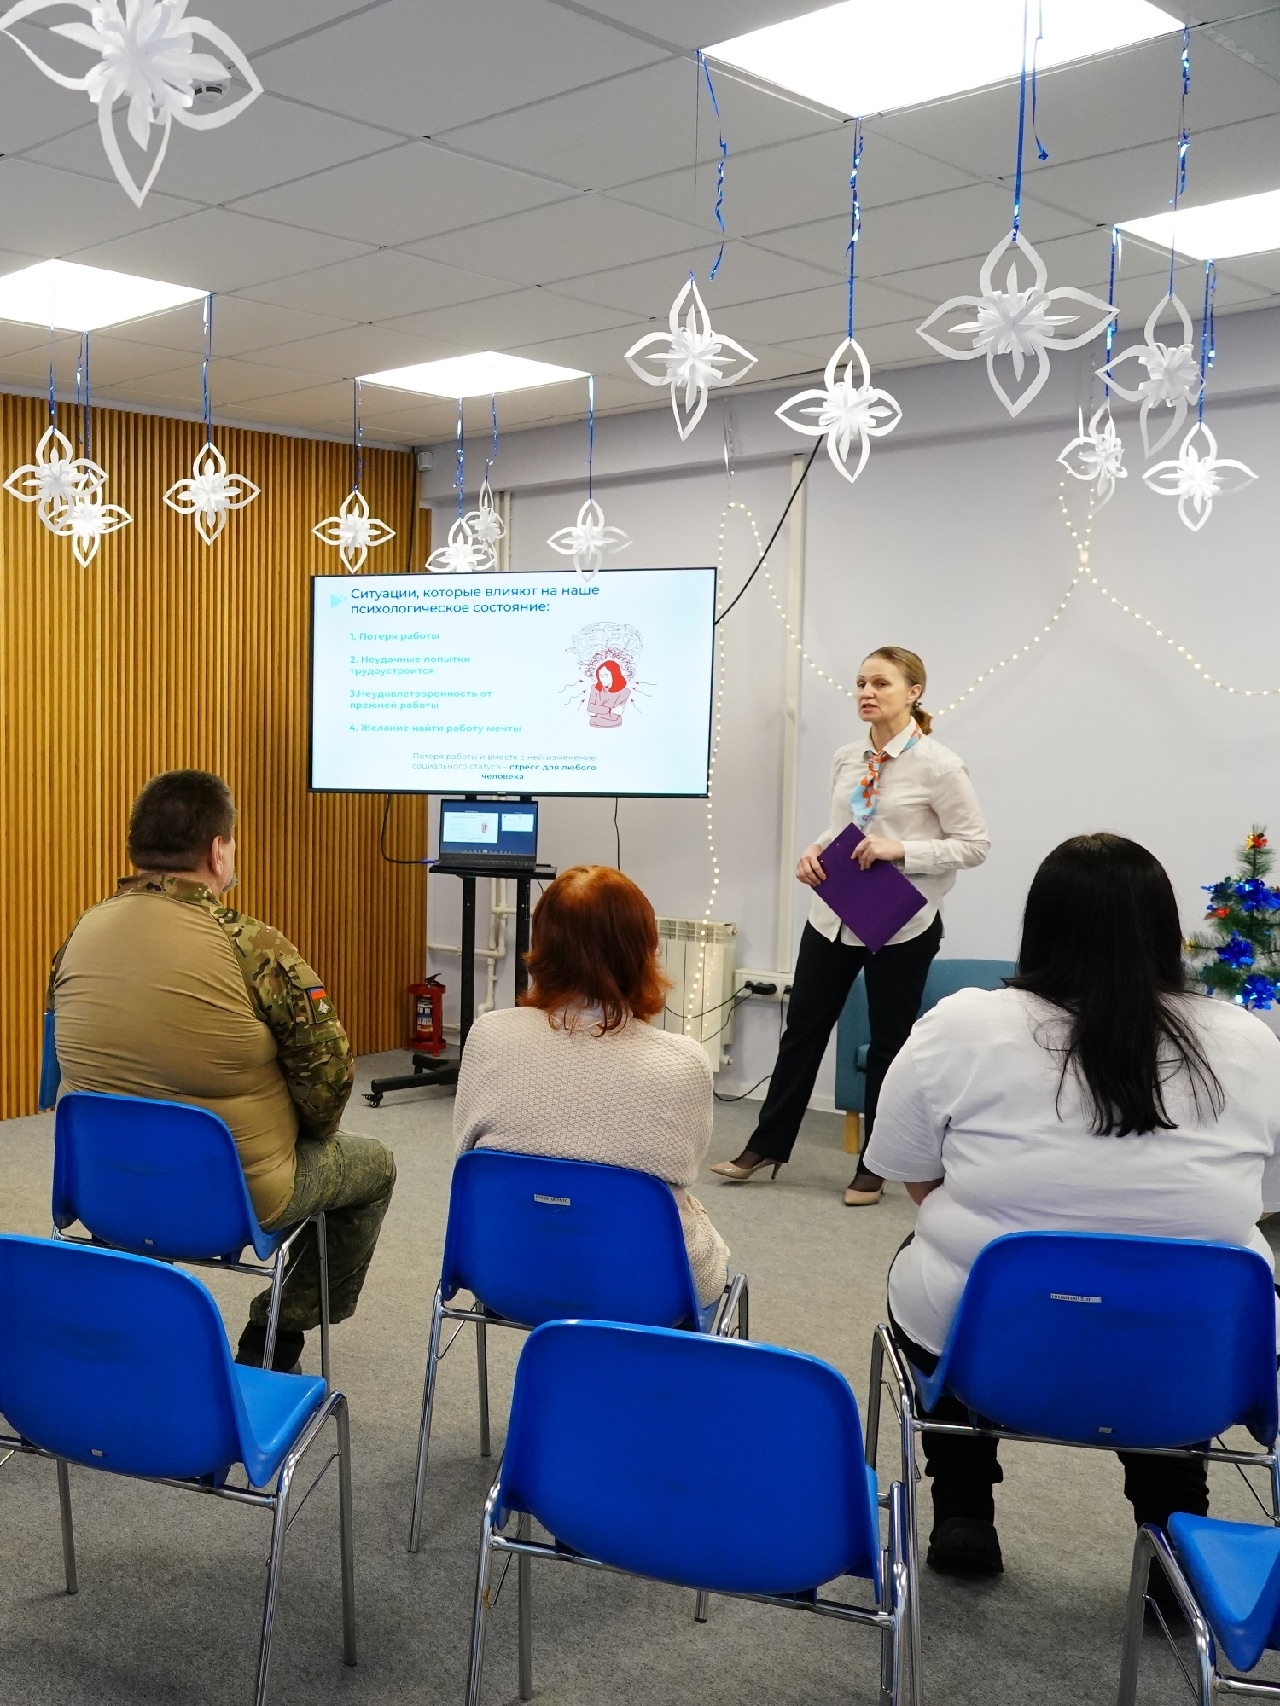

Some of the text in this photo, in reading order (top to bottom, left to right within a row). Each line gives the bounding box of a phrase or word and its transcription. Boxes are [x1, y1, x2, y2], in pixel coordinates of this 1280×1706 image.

[351, 586, 600, 601] Ситуации, которые влияют на наше
[351, 603, 550, 614] психологическое состояние:
[349, 631, 440, 642] 1. Потеря работы
[349, 655, 471, 665] 2. Неудачные попытки
[350, 701, 440, 711] прежней работы
[349, 724, 523, 735] 4. Желание найти работу мечты
[413, 752, 444, 761] Потеря
